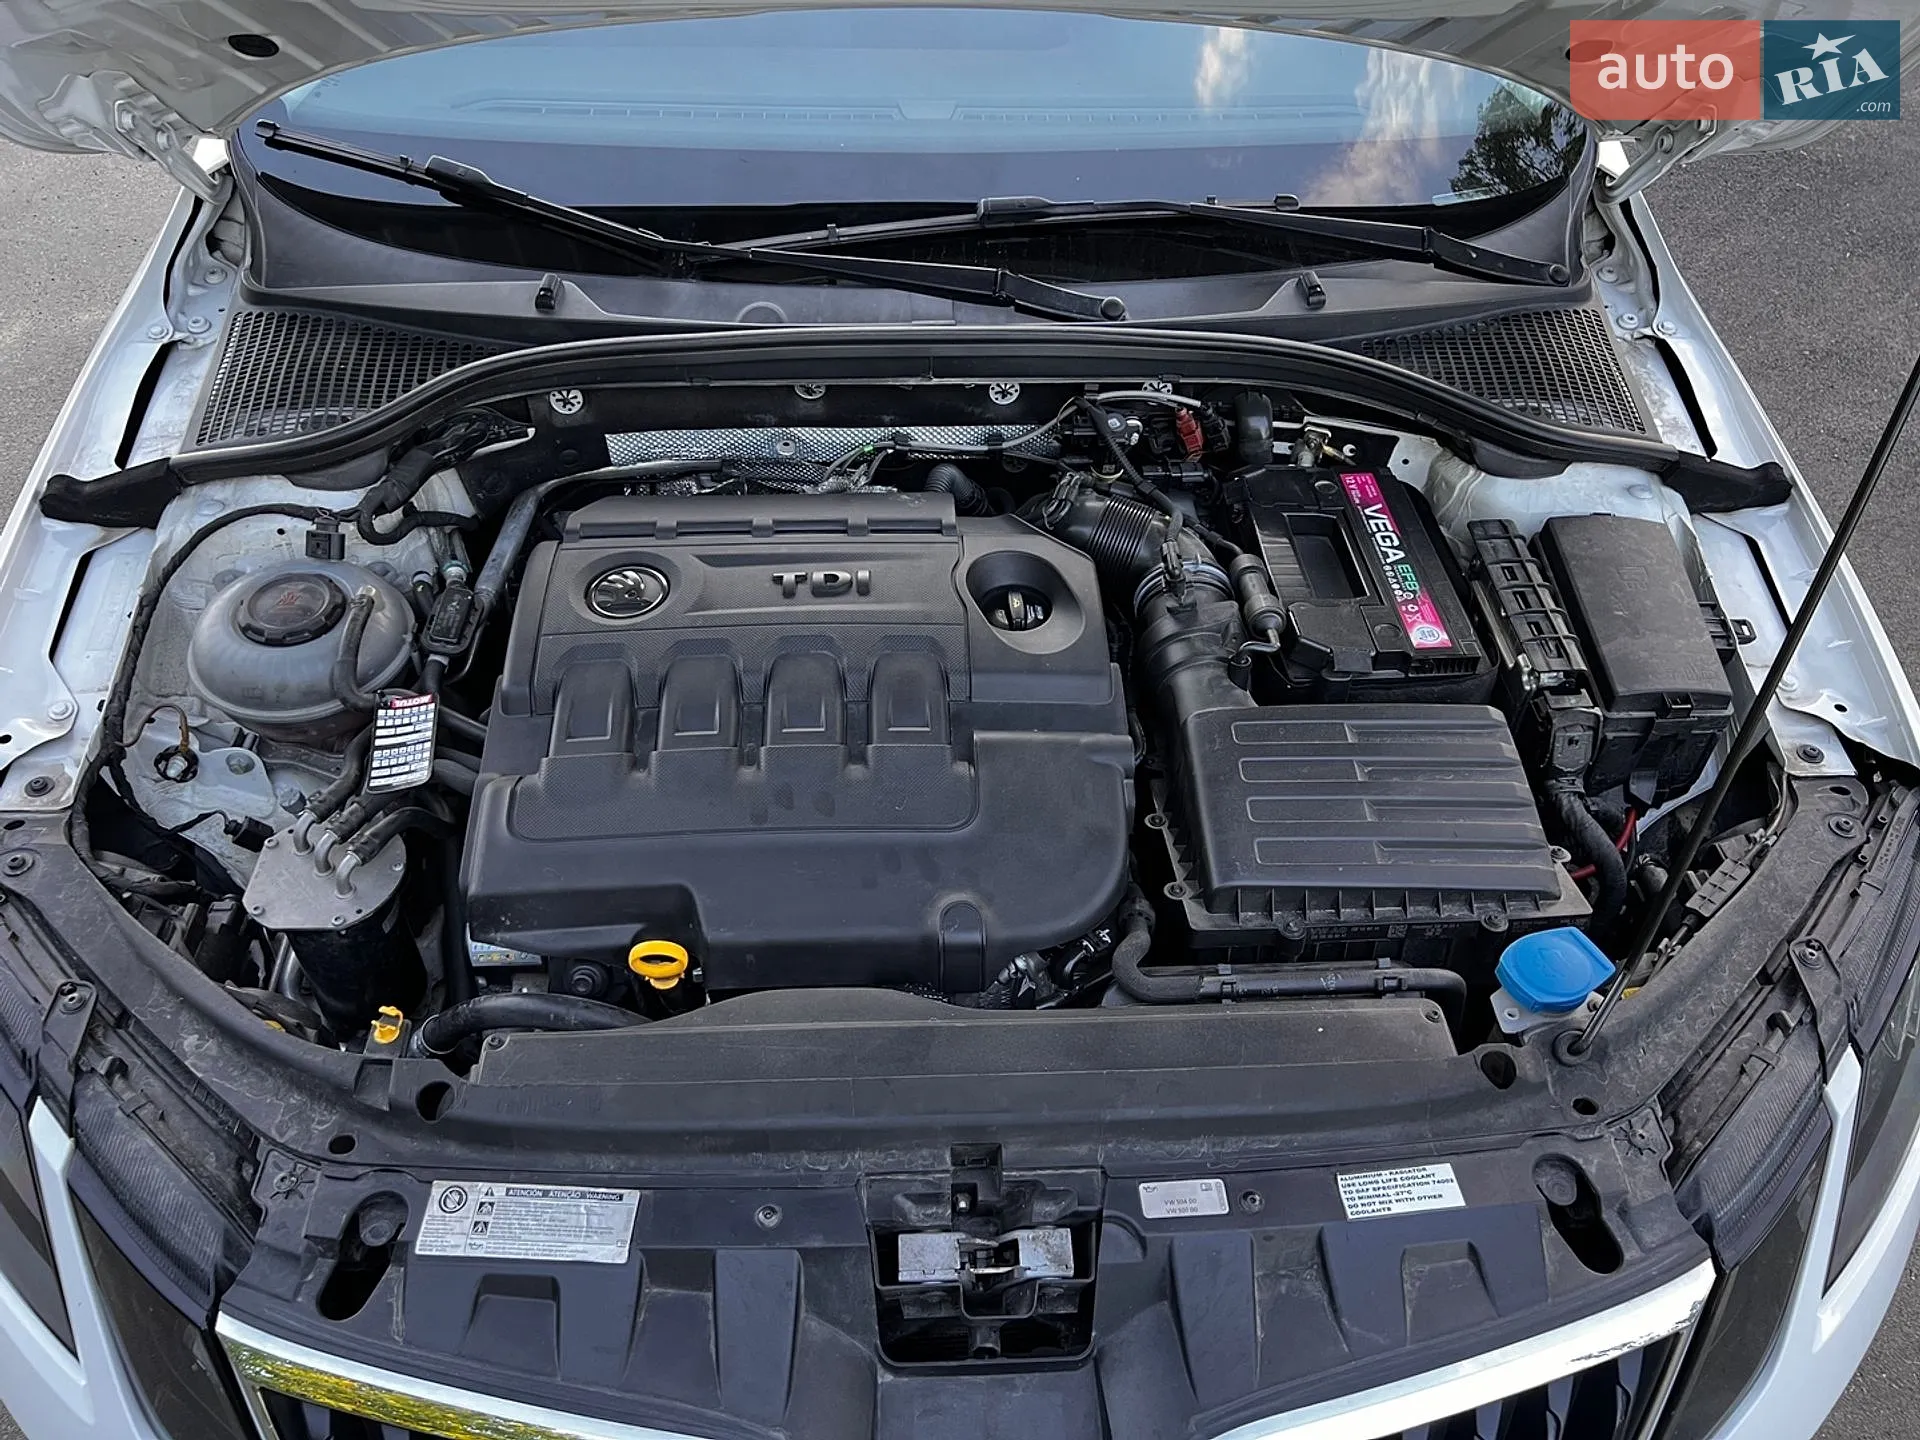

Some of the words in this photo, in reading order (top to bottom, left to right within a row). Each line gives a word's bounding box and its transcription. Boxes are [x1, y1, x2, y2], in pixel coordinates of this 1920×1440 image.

[1363, 503, 1406, 564] VEGA
[1397, 564, 1419, 591] EFB
[772, 570, 871, 599] TDI
[394, 694, 431, 707] MOTUL
[1340, 1172, 1383, 1182] ALUMINIUM
[1389, 1167, 1428, 1177] RADIATOR
[1400, 1172, 1436, 1182] COOLANT
[1372, 1181, 1430, 1192] SPECIFICATION
[1357, 1193, 1392, 1202] MINIMAL
[1417, 1193, 1443, 1201] OTHER
[1350, 1207, 1392, 1216] COOLANTS
